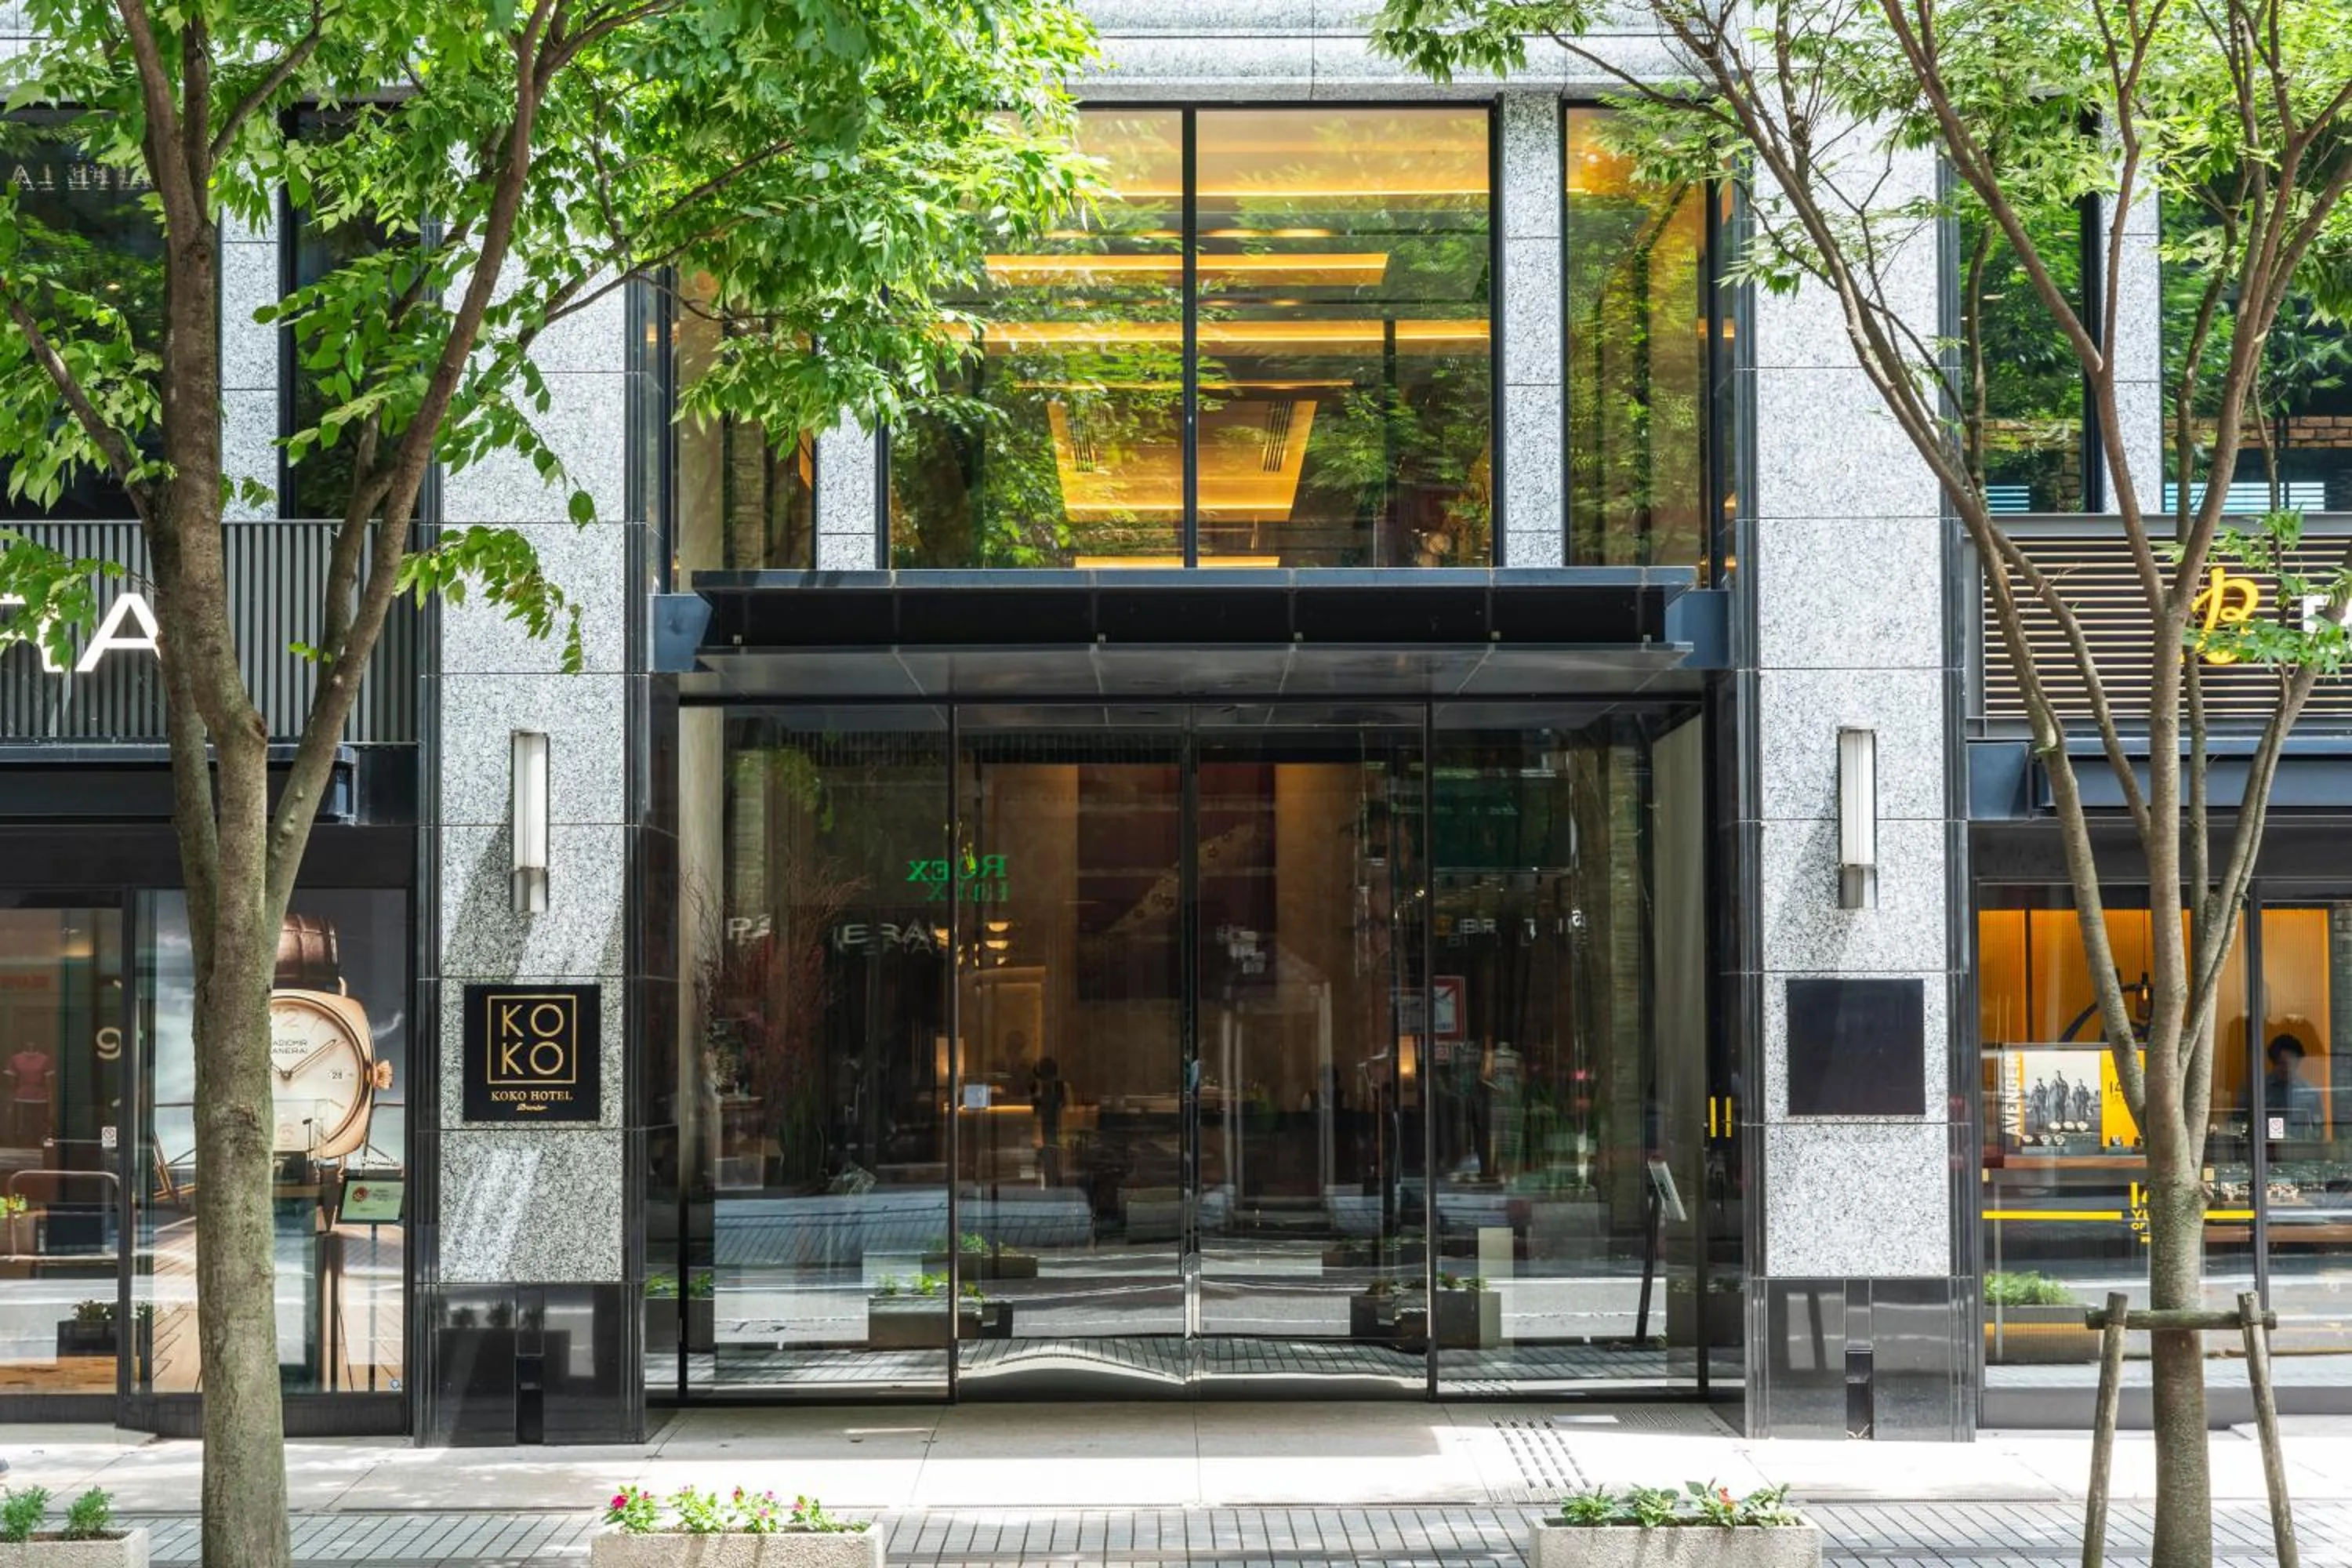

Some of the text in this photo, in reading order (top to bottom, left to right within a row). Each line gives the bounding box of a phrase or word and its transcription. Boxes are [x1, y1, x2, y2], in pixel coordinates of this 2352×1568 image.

[502, 1004, 564, 1037] KO
[502, 1041, 564, 1075] KO
[491, 1091, 573, 1101] KOKO HOTEL
